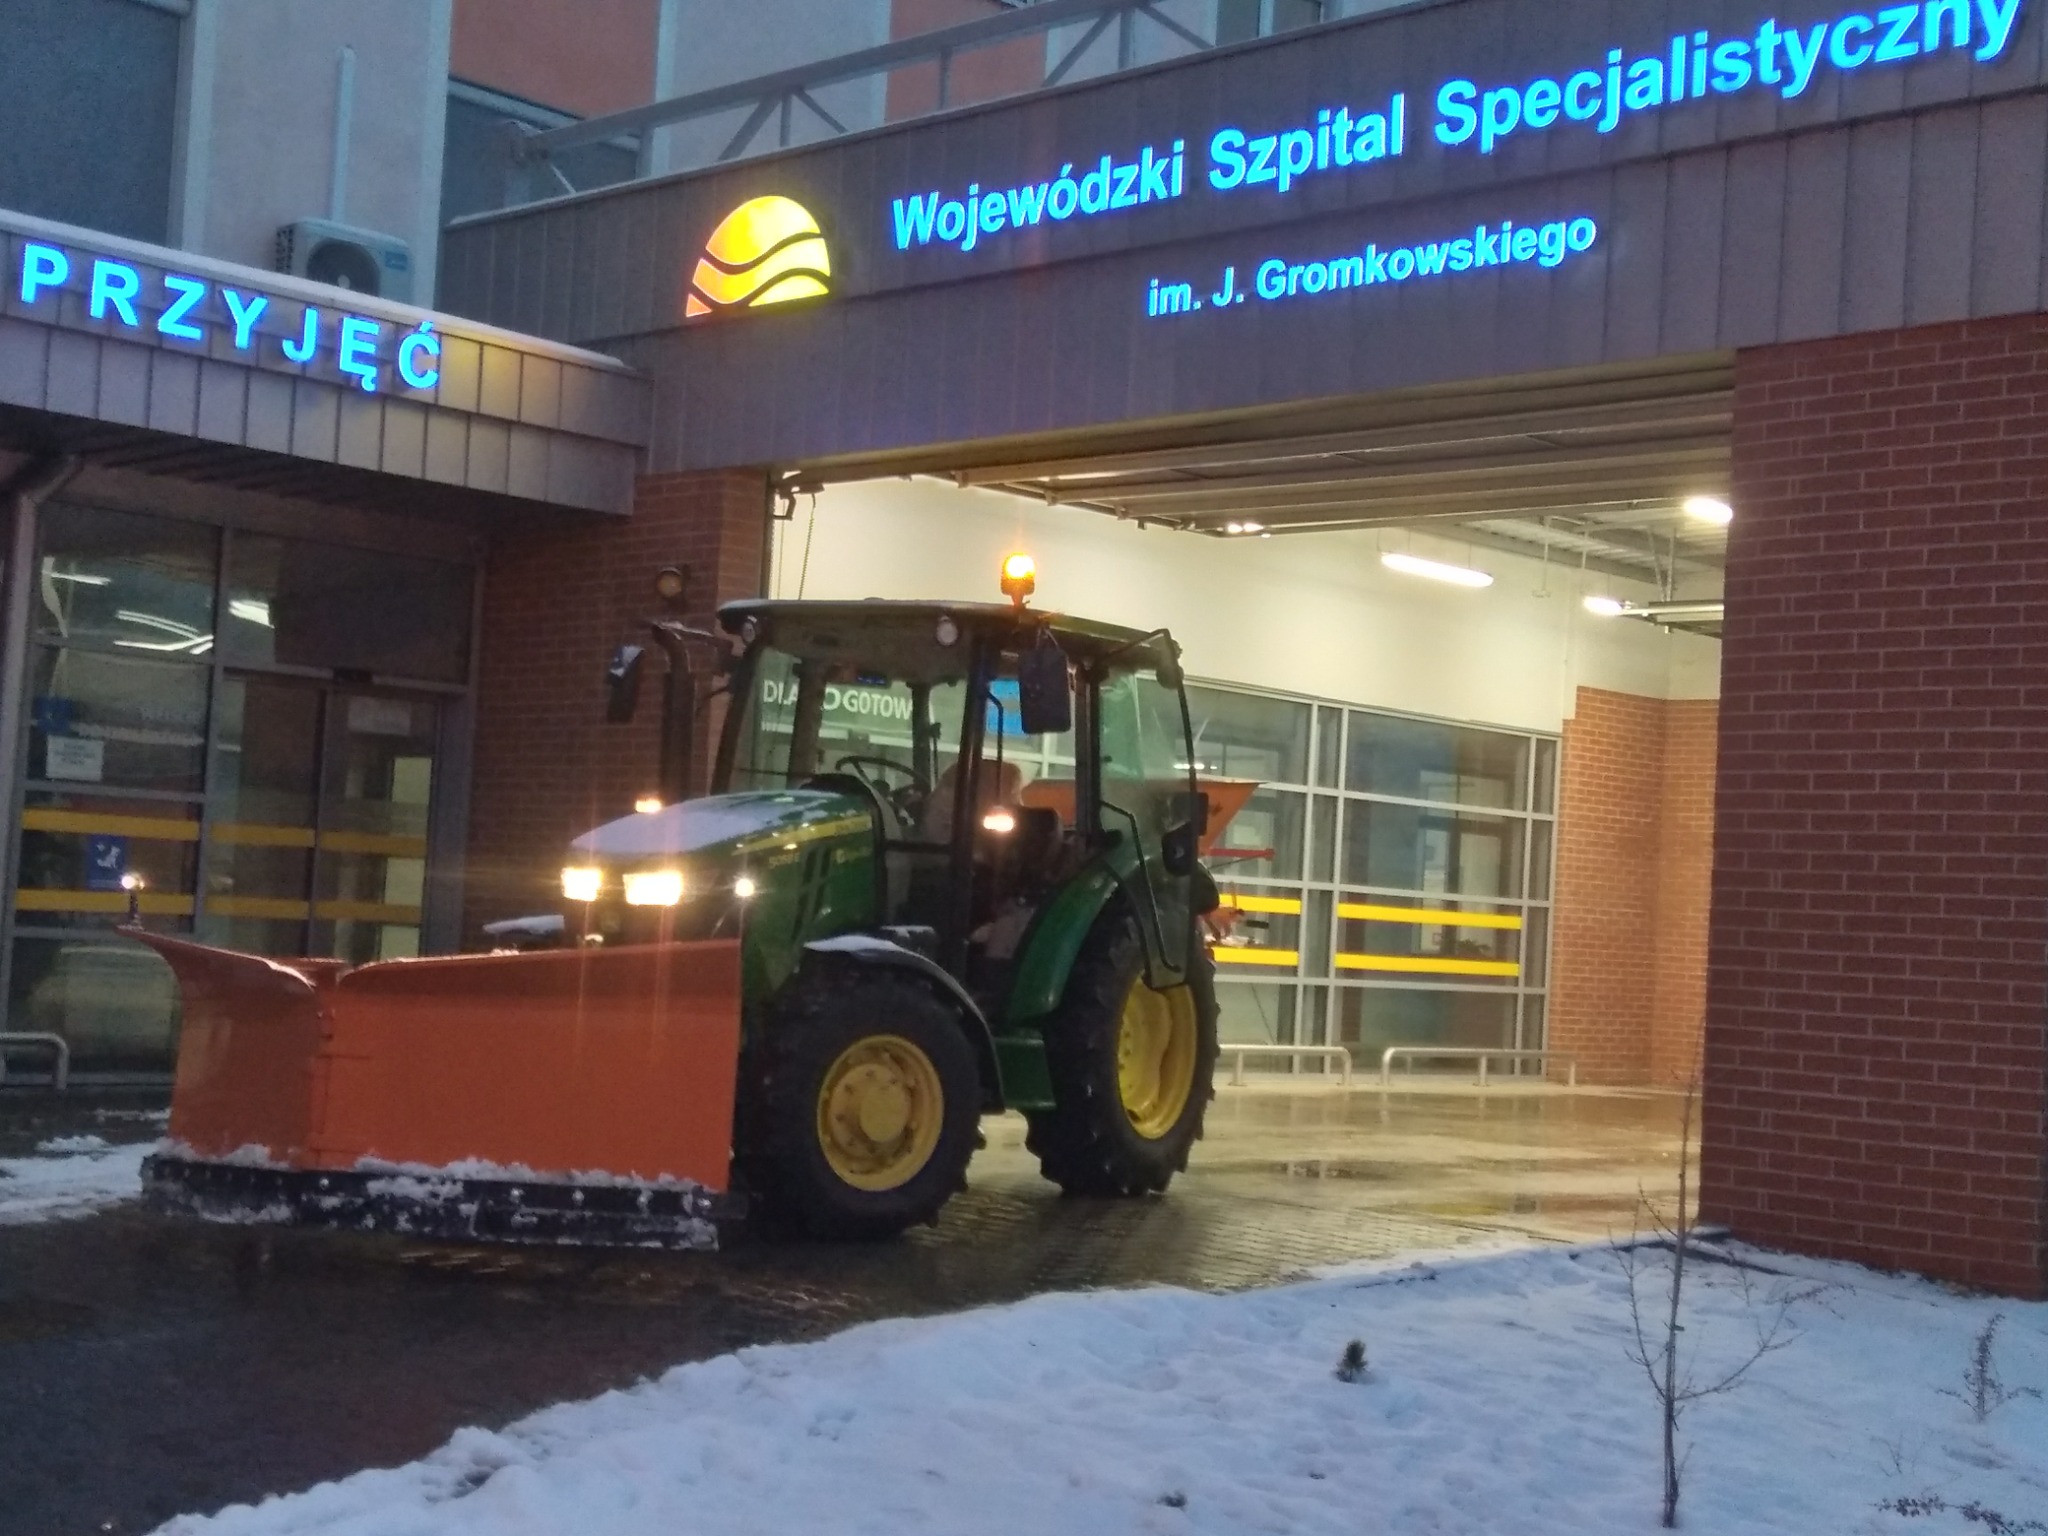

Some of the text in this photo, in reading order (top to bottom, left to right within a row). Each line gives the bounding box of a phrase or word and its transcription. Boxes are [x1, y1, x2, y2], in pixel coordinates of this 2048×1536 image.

[891, 0, 2021, 253] Wojewódzki Szpital Specjalistyczny
[20, 241, 442, 393] PRZYJĘĆ
[1147, 216, 1597, 318] im. J. Gromkowskiego
[822, 686, 914, 721] OGOTOW
